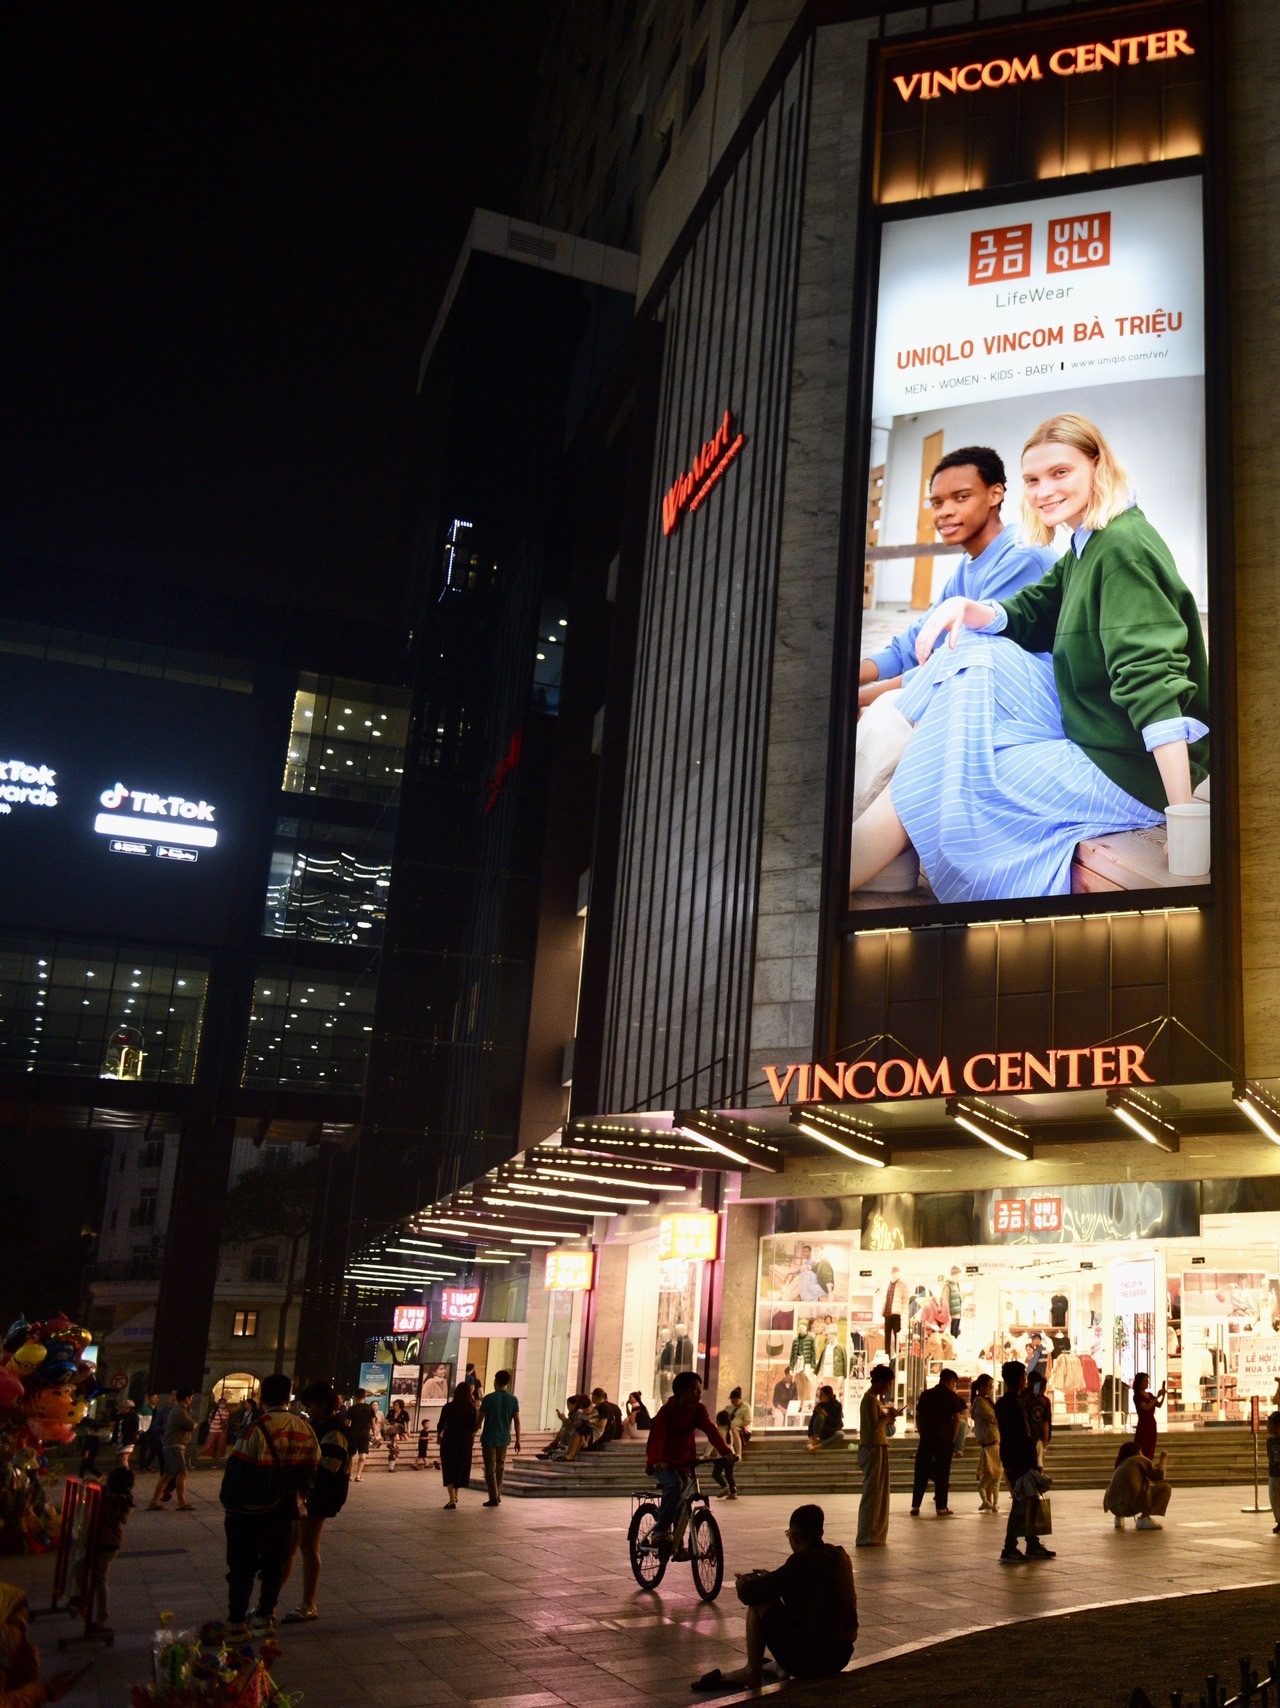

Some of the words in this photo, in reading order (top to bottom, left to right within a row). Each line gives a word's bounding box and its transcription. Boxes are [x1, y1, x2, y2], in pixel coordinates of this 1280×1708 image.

[894, 55, 1042, 102] VINCOM
[1049, 29, 1195, 76] CENTER
[1054, 219, 1100, 243] UNI
[1053, 241, 1104, 269] QLO
[995, 287, 1074, 308] LifeWear
[897, 340, 974, 370] UNIQLO
[983, 326, 1064, 355] VINCOM
[1073, 315, 1104, 342] BÀ
[1115, 308, 1183, 338] TRIỆU
[904, 383, 928, 396] MEN
[938, 375, 980, 390] WOMEN
[990, 369, 1014, 381] KIDS
[1025, 363, 1055, 377] BABY
[1070, 350, 1169, 369] www.uniqlo.com/vn/
[131, 790, 216, 821] TikTok
[762, 1056, 956, 1103] VINCOM
[963, 1045, 1155, 1092] CENTER
